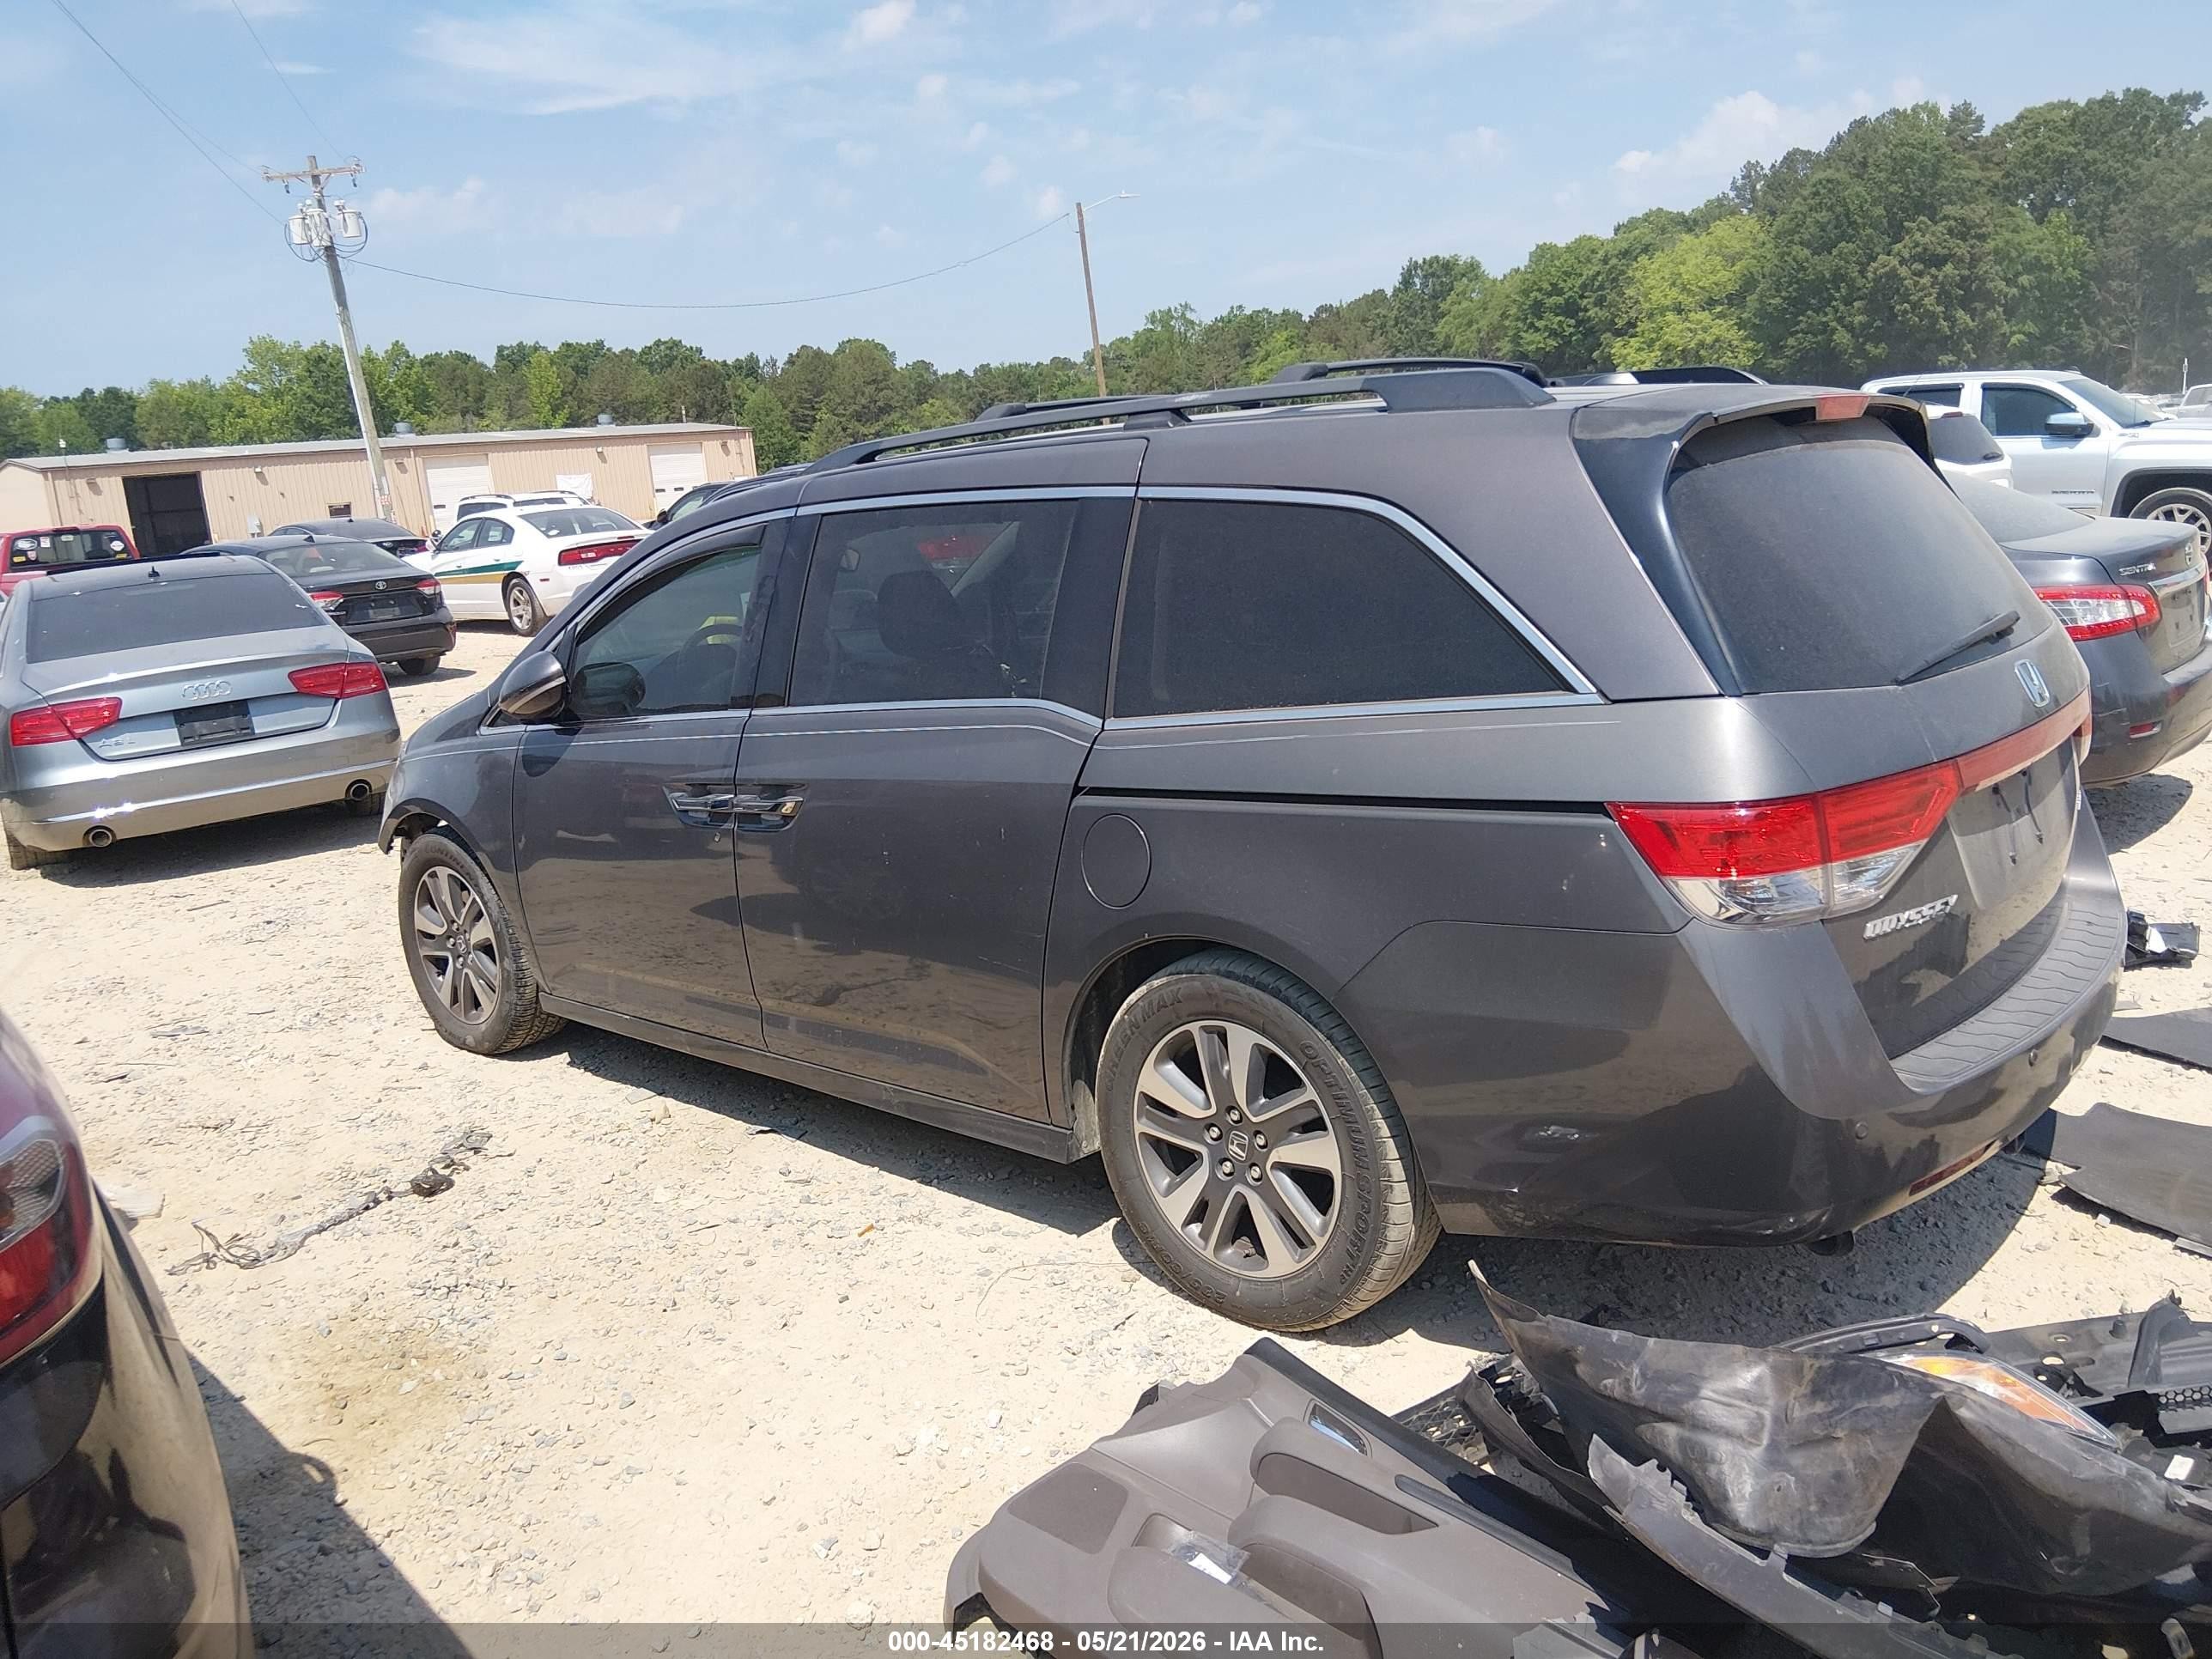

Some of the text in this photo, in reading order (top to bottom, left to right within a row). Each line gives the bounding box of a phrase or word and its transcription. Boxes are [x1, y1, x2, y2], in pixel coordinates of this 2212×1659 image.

[1863, 894, 1959, 940] ODYSSEY
[1139, 987, 1182, 1023] MAX
[1299, 1040, 1370, 1170] OPTIMUM
